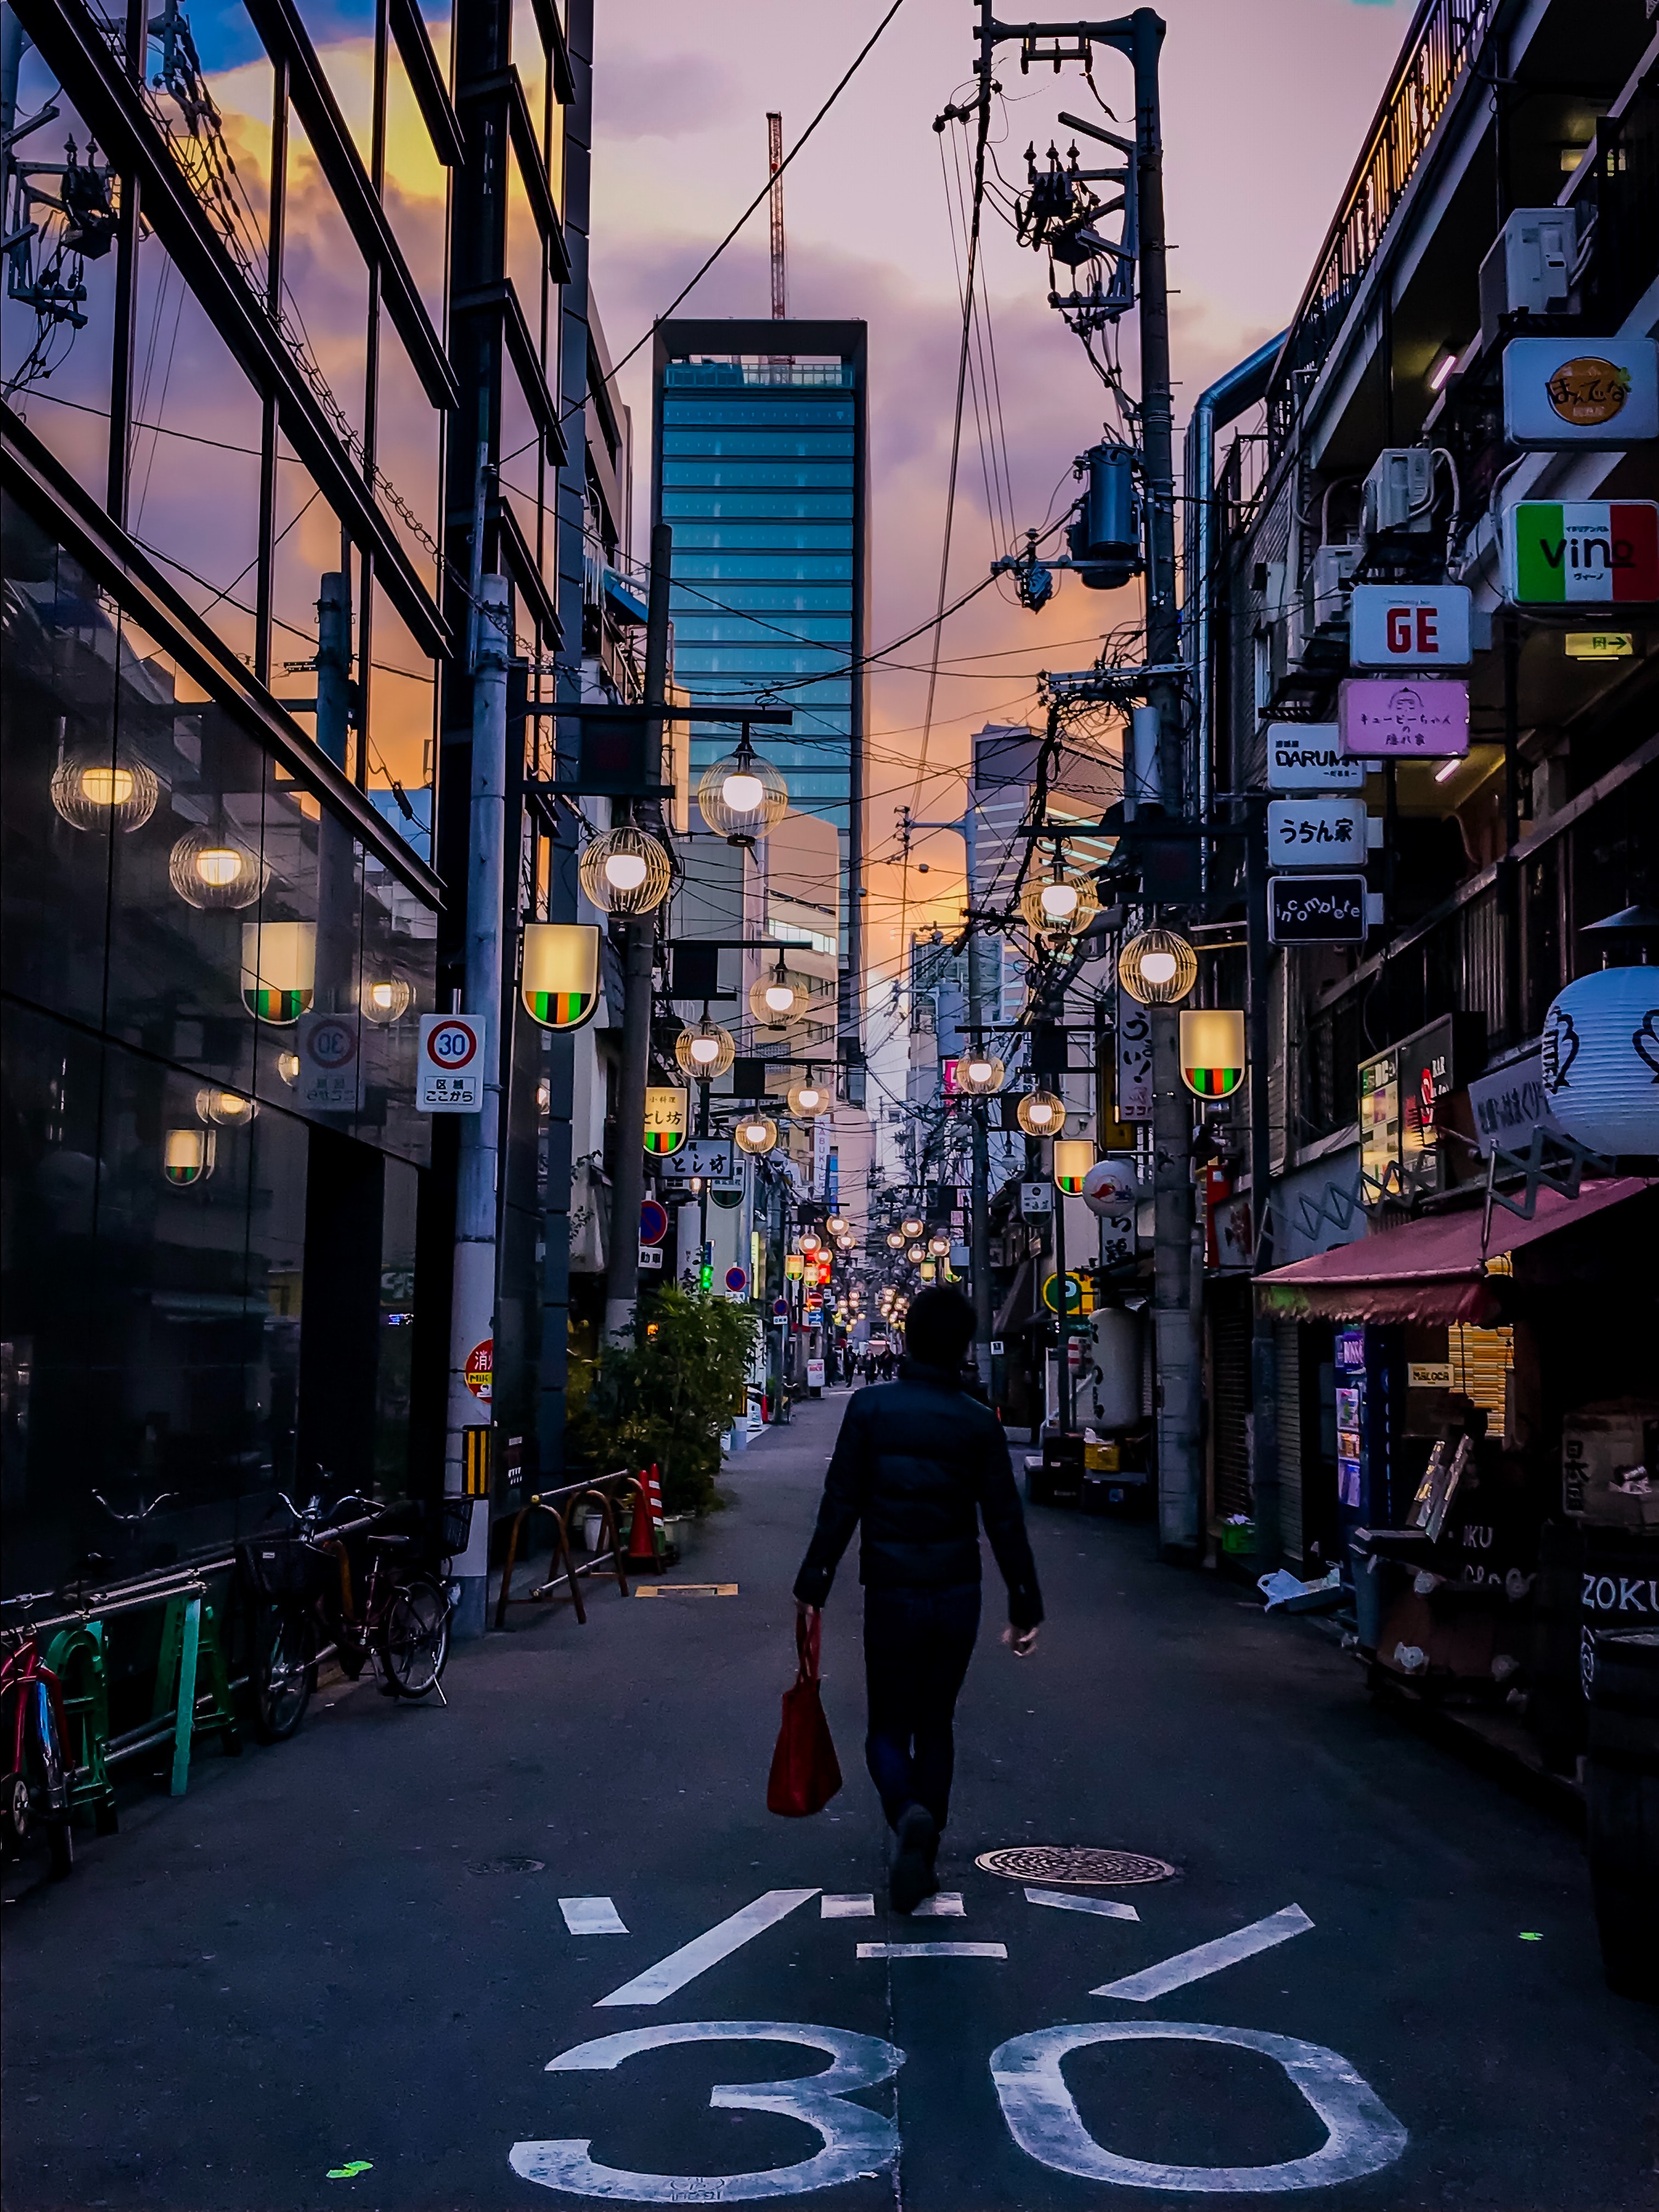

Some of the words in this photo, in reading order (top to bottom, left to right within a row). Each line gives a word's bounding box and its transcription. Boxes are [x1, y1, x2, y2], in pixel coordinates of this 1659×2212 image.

[1539, 538, 1637, 569] vino
[1386, 607, 1438, 653] GE
[1279, 817, 1354, 844] うちん家
[1276, 895, 1361, 922] incomplete
[439, 1034, 466, 1056] 30
[426, 1090, 473, 1102] ここから
[644, 1110, 682, 1125] とし坊
[672, 1153, 727, 1174] とし坊
[507, 2021, 1409, 2204] 30
